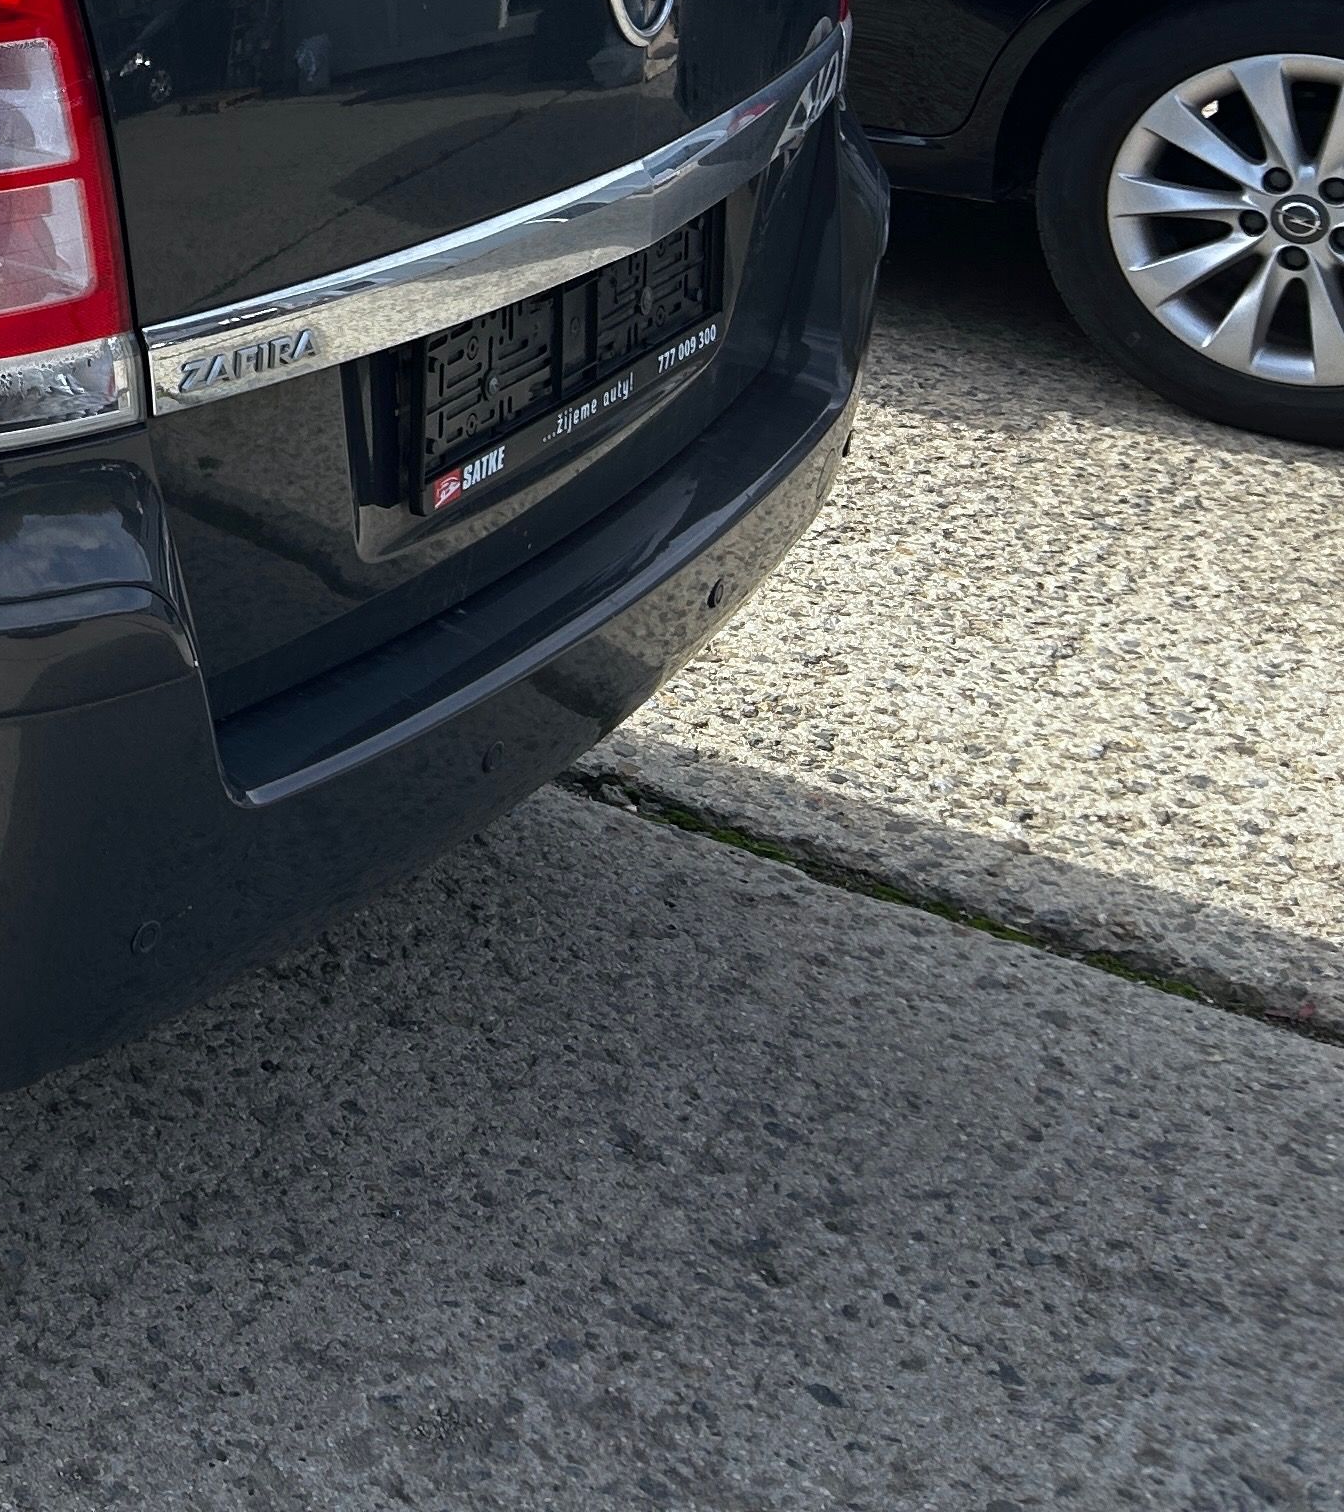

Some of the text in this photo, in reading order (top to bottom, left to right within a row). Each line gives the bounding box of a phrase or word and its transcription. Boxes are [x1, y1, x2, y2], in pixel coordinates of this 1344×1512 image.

[177, 327, 320, 393] ZAFIRA
[658, 323, 717, 374] 777 009 300
[542, 371, 633, 443] ...žijeme auty!
[462, 445, 506, 490] SATKE
